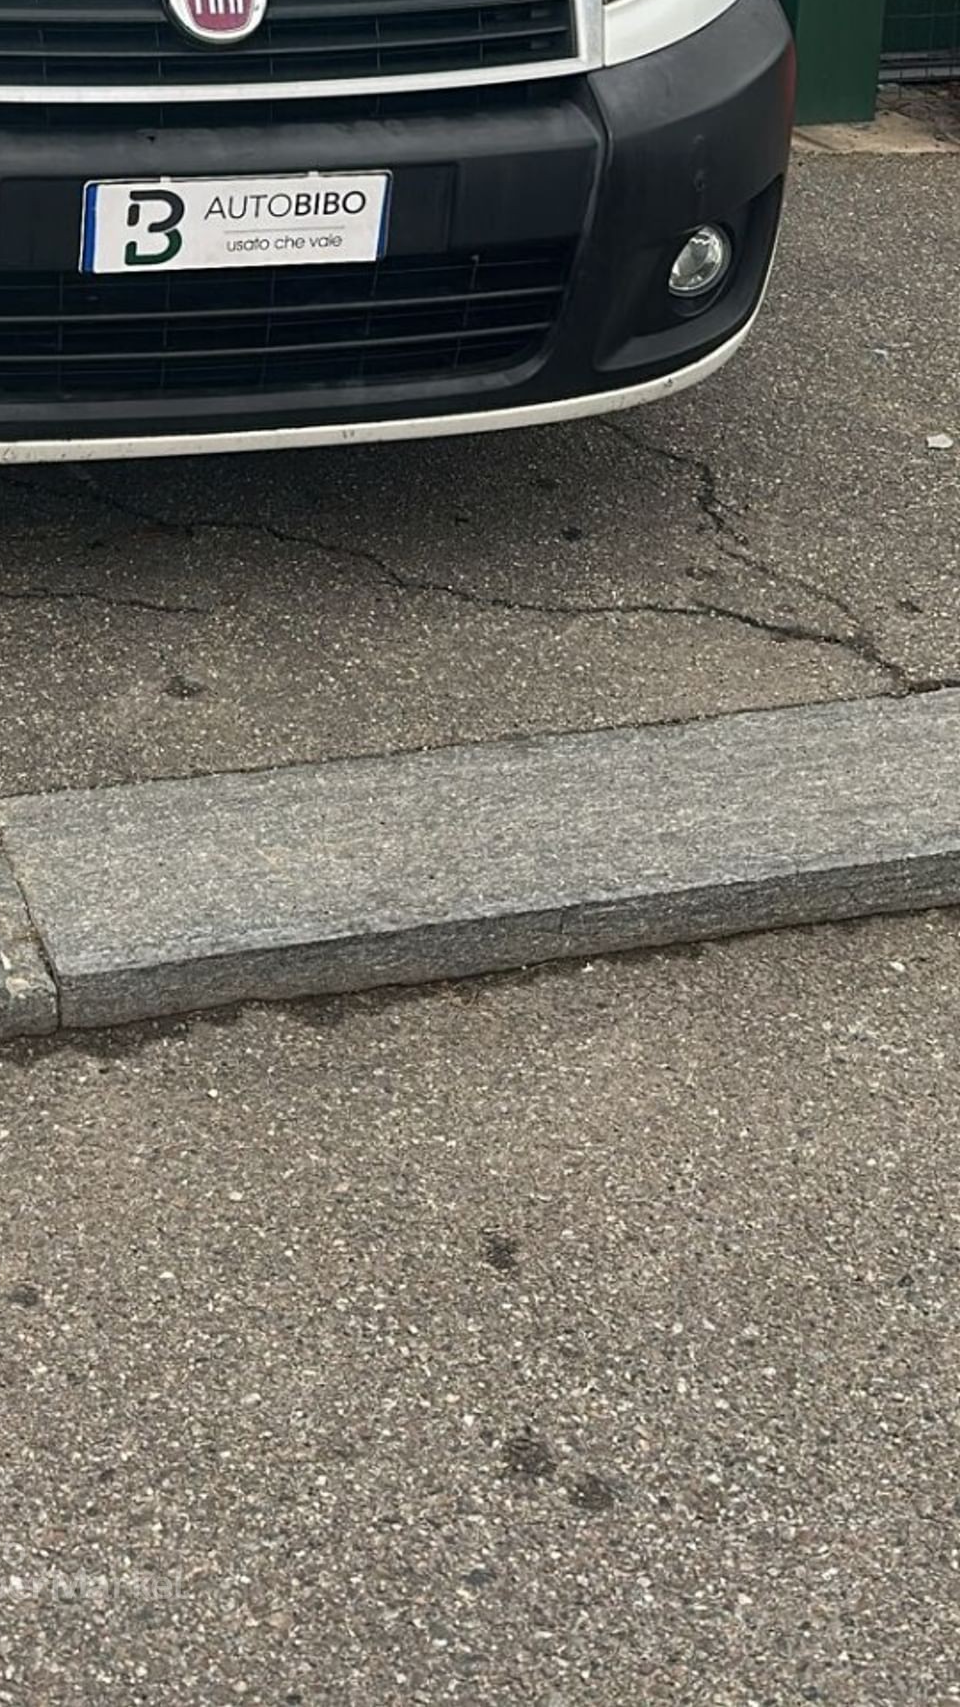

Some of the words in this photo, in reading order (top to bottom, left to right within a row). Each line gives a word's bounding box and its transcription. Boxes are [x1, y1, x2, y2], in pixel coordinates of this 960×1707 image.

[203, 190, 367, 220] AUTOBIBO
[226, 237, 270, 253] usato
[274, 233, 305, 251] che
